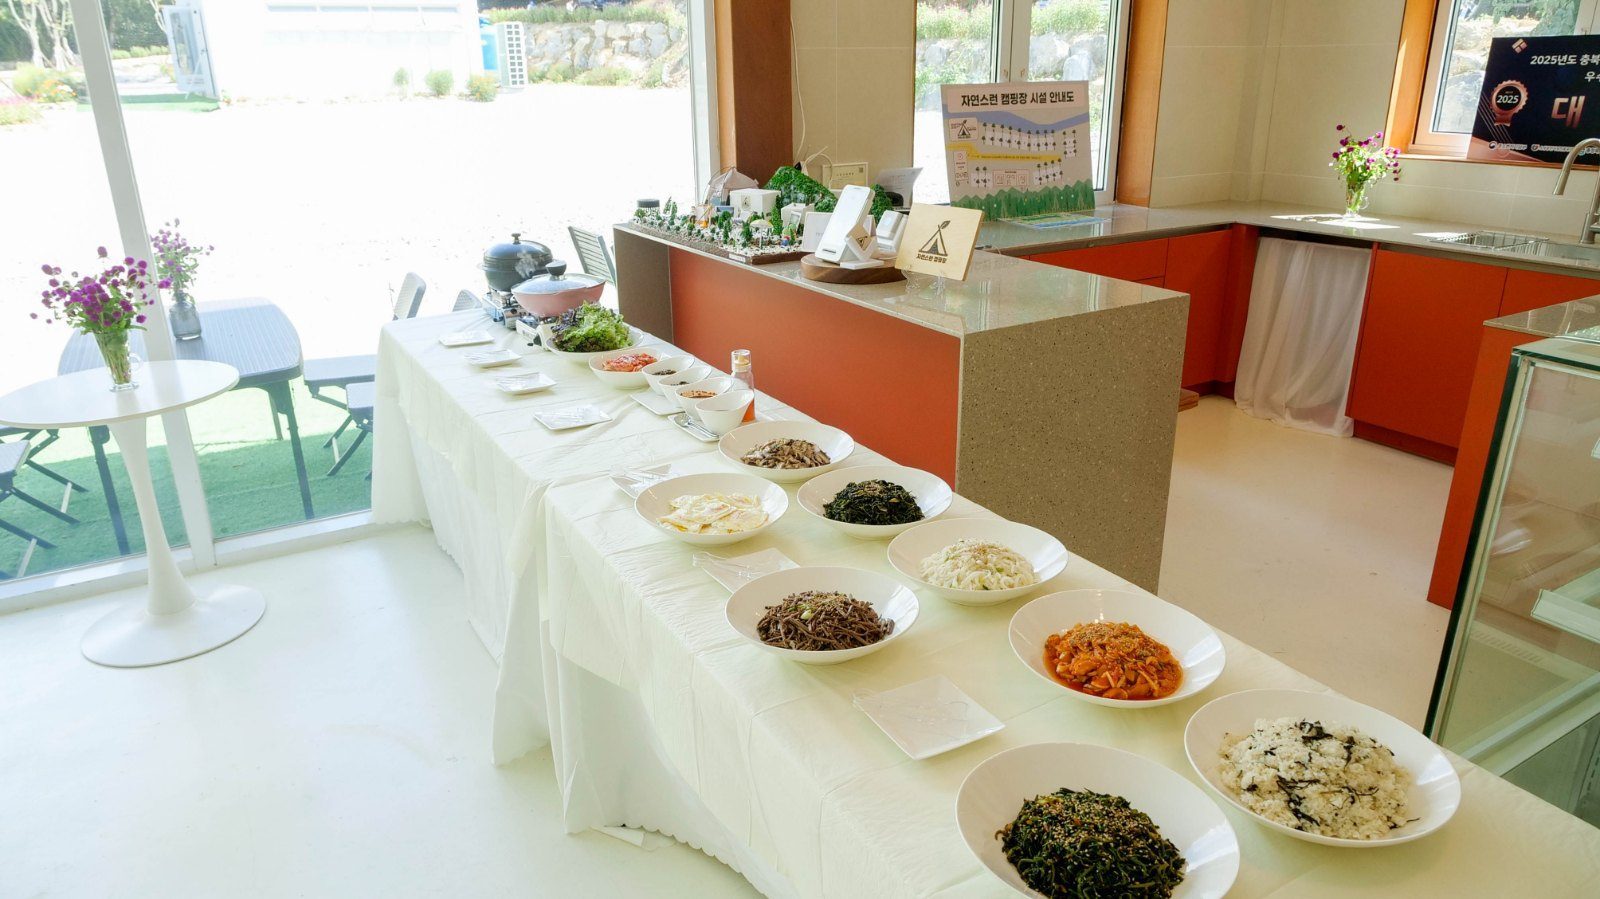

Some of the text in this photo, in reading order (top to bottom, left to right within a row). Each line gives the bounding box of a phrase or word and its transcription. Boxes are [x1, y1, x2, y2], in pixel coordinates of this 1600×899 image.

[1530, 55, 1577, 65] 2025년도
[961, 91, 1074, 106] 자연스런 캠핑장 시설 안내도
[1497, 94, 1519, 104] 2025
[1551, 95, 1586, 128] 대
